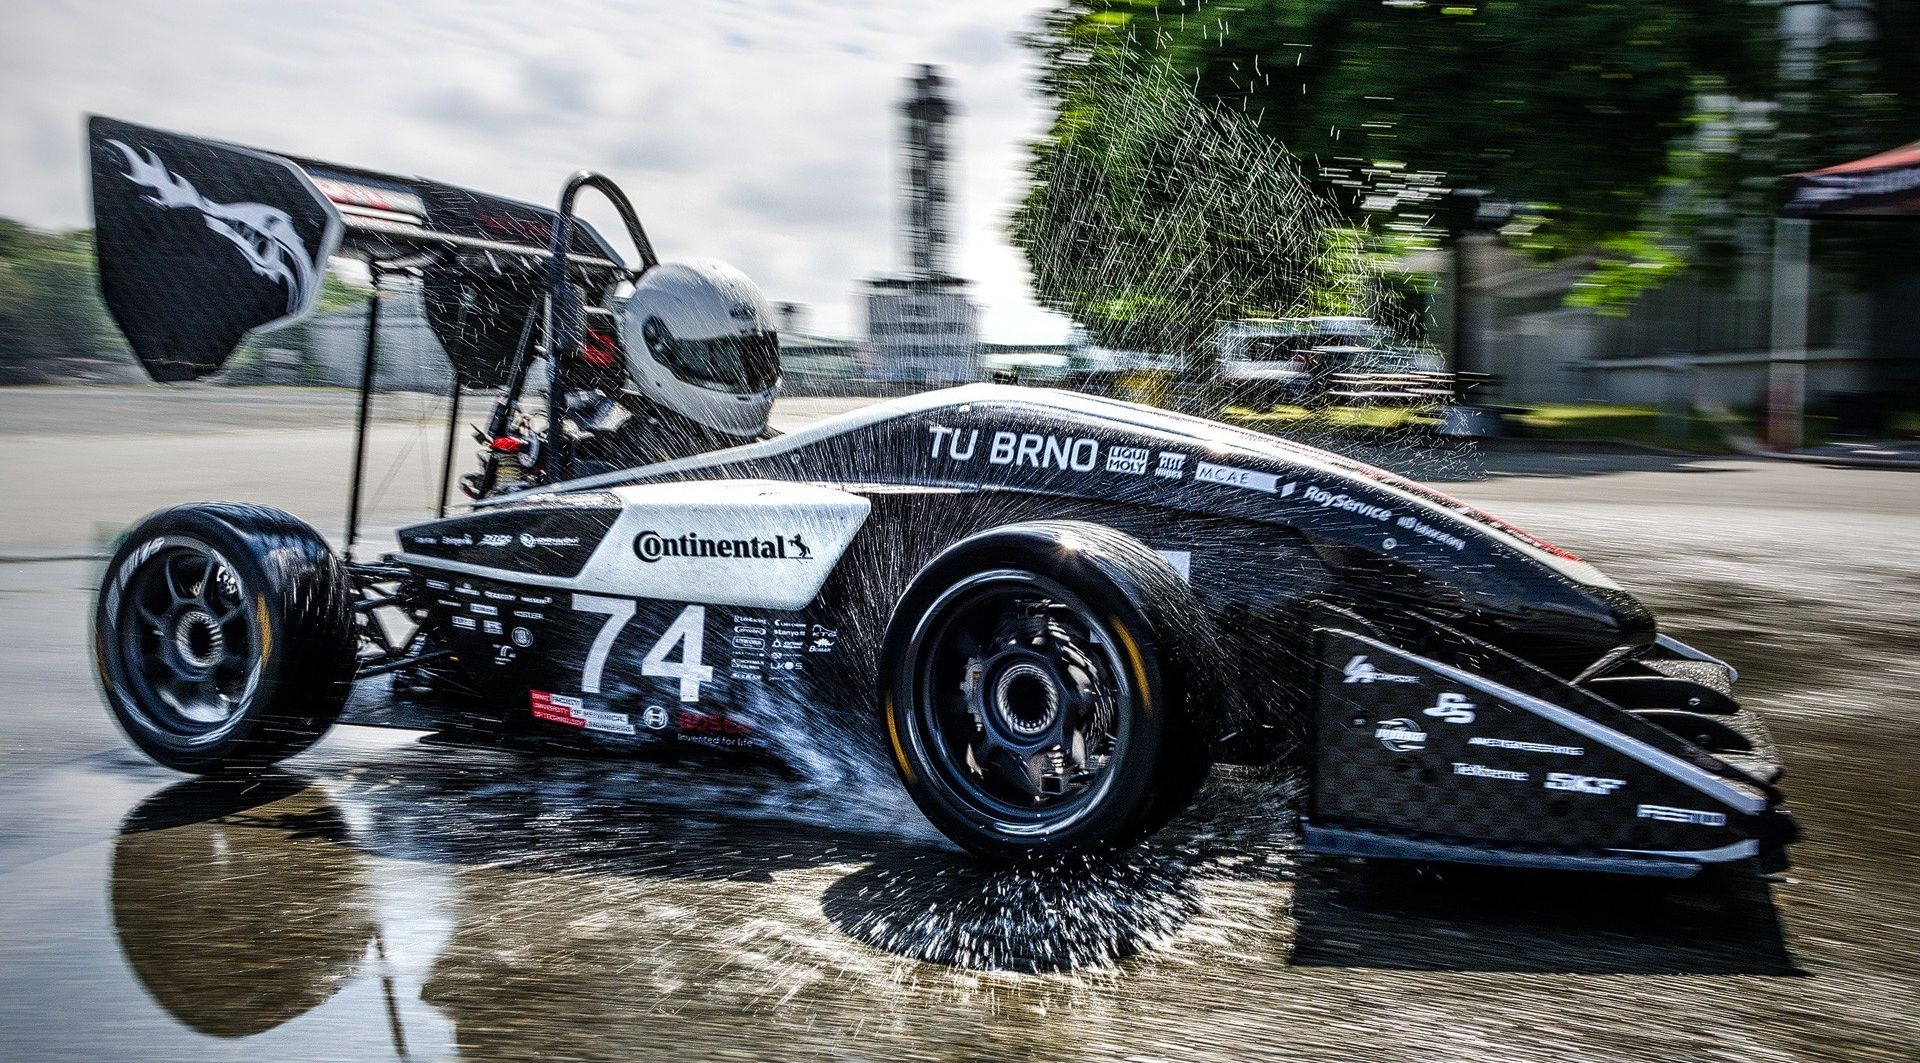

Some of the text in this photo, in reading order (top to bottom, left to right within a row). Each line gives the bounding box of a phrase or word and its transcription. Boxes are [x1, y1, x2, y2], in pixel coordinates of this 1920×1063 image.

[929, 426, 1099, 472] TU BRNO
[1110, 445, 1149, 462] LIQUI
[1108, 459, 1146, 473] MOLY
[1199, 466, 1249, 486] MCAE
[632, 530, 787, 563] Continental
[571, 593, 713, 702] 74
[722, 736, 736, 746] for
[737, 738, 753, 747] life
[1544, 772, 1628, 795] SKF
